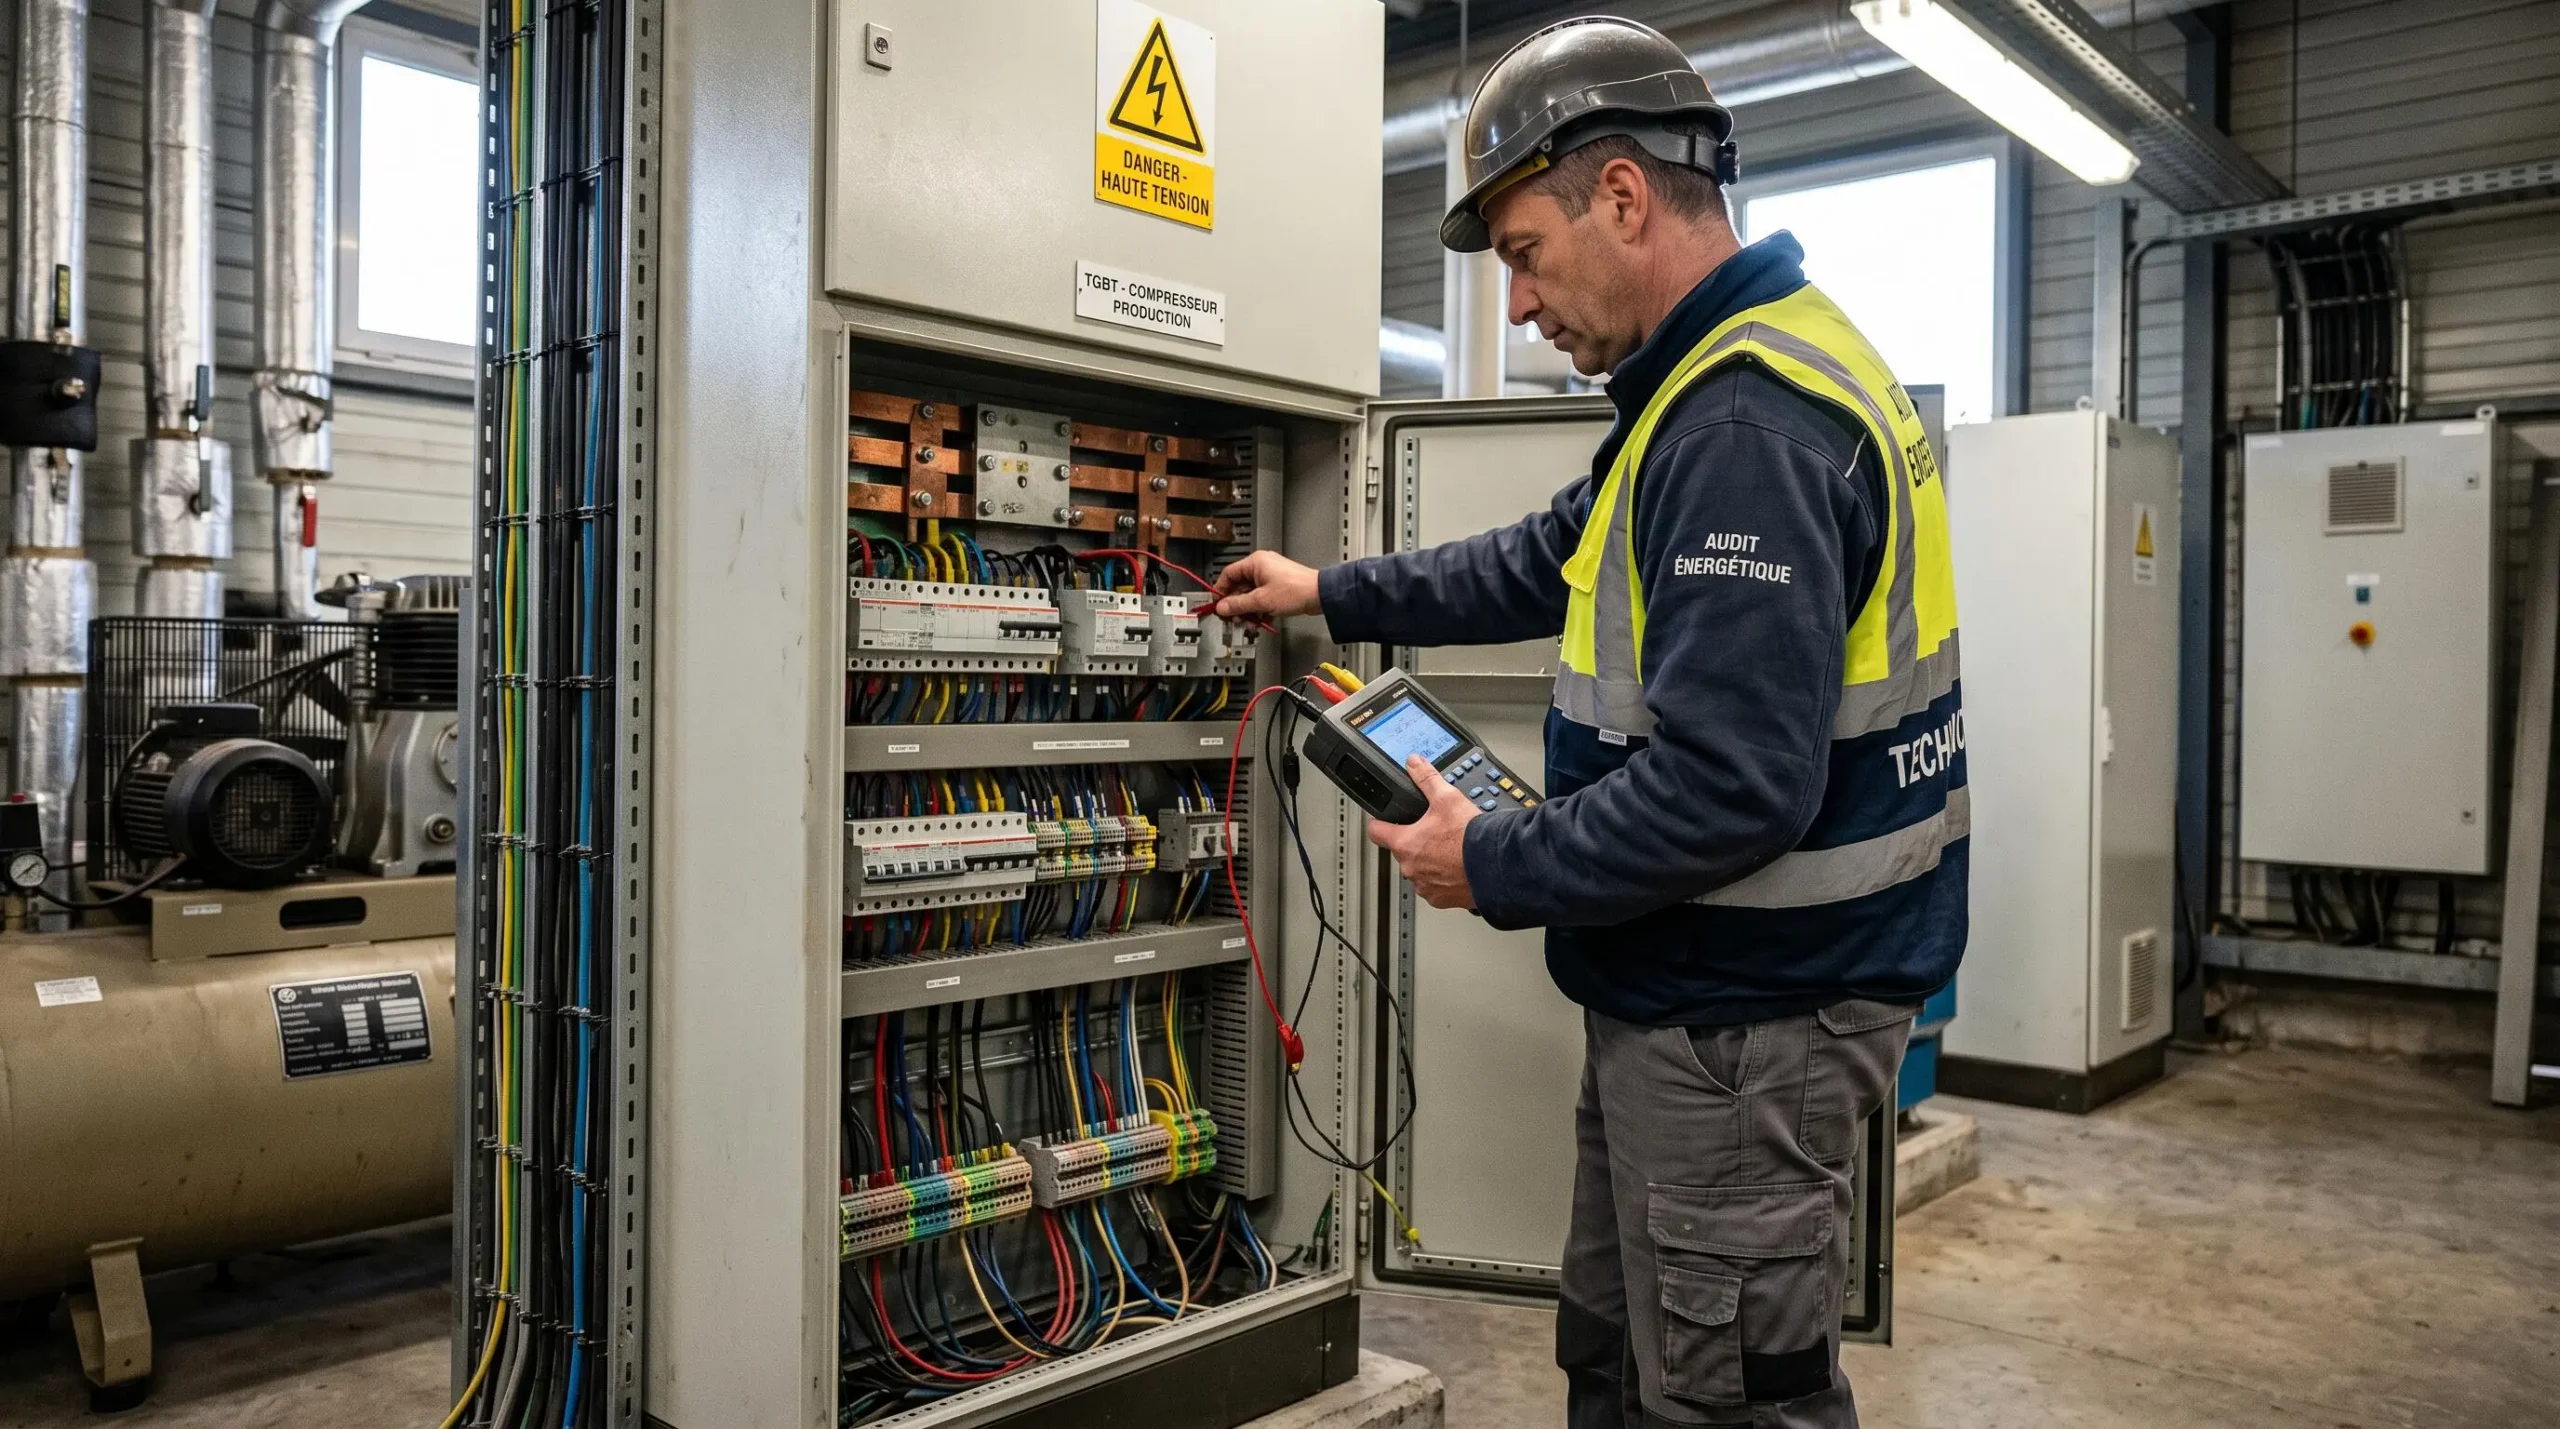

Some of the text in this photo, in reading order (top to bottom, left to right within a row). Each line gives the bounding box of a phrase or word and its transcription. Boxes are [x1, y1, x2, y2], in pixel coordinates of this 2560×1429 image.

[1124, 150, 1180, 183] DANGER
[1102, 170, 1209, 217] HAUTE TENSION
[1084, 272, 1118, 293] TGBT
[1129, 283, 1217, 315] COMPRESSEUR
[1113, 300, 1191, 329] PRODUCTION
[1704, 533, 1760, 553] AUDIT
[1674, 554, 1792, 584] ÉNERGÉTIQUE
